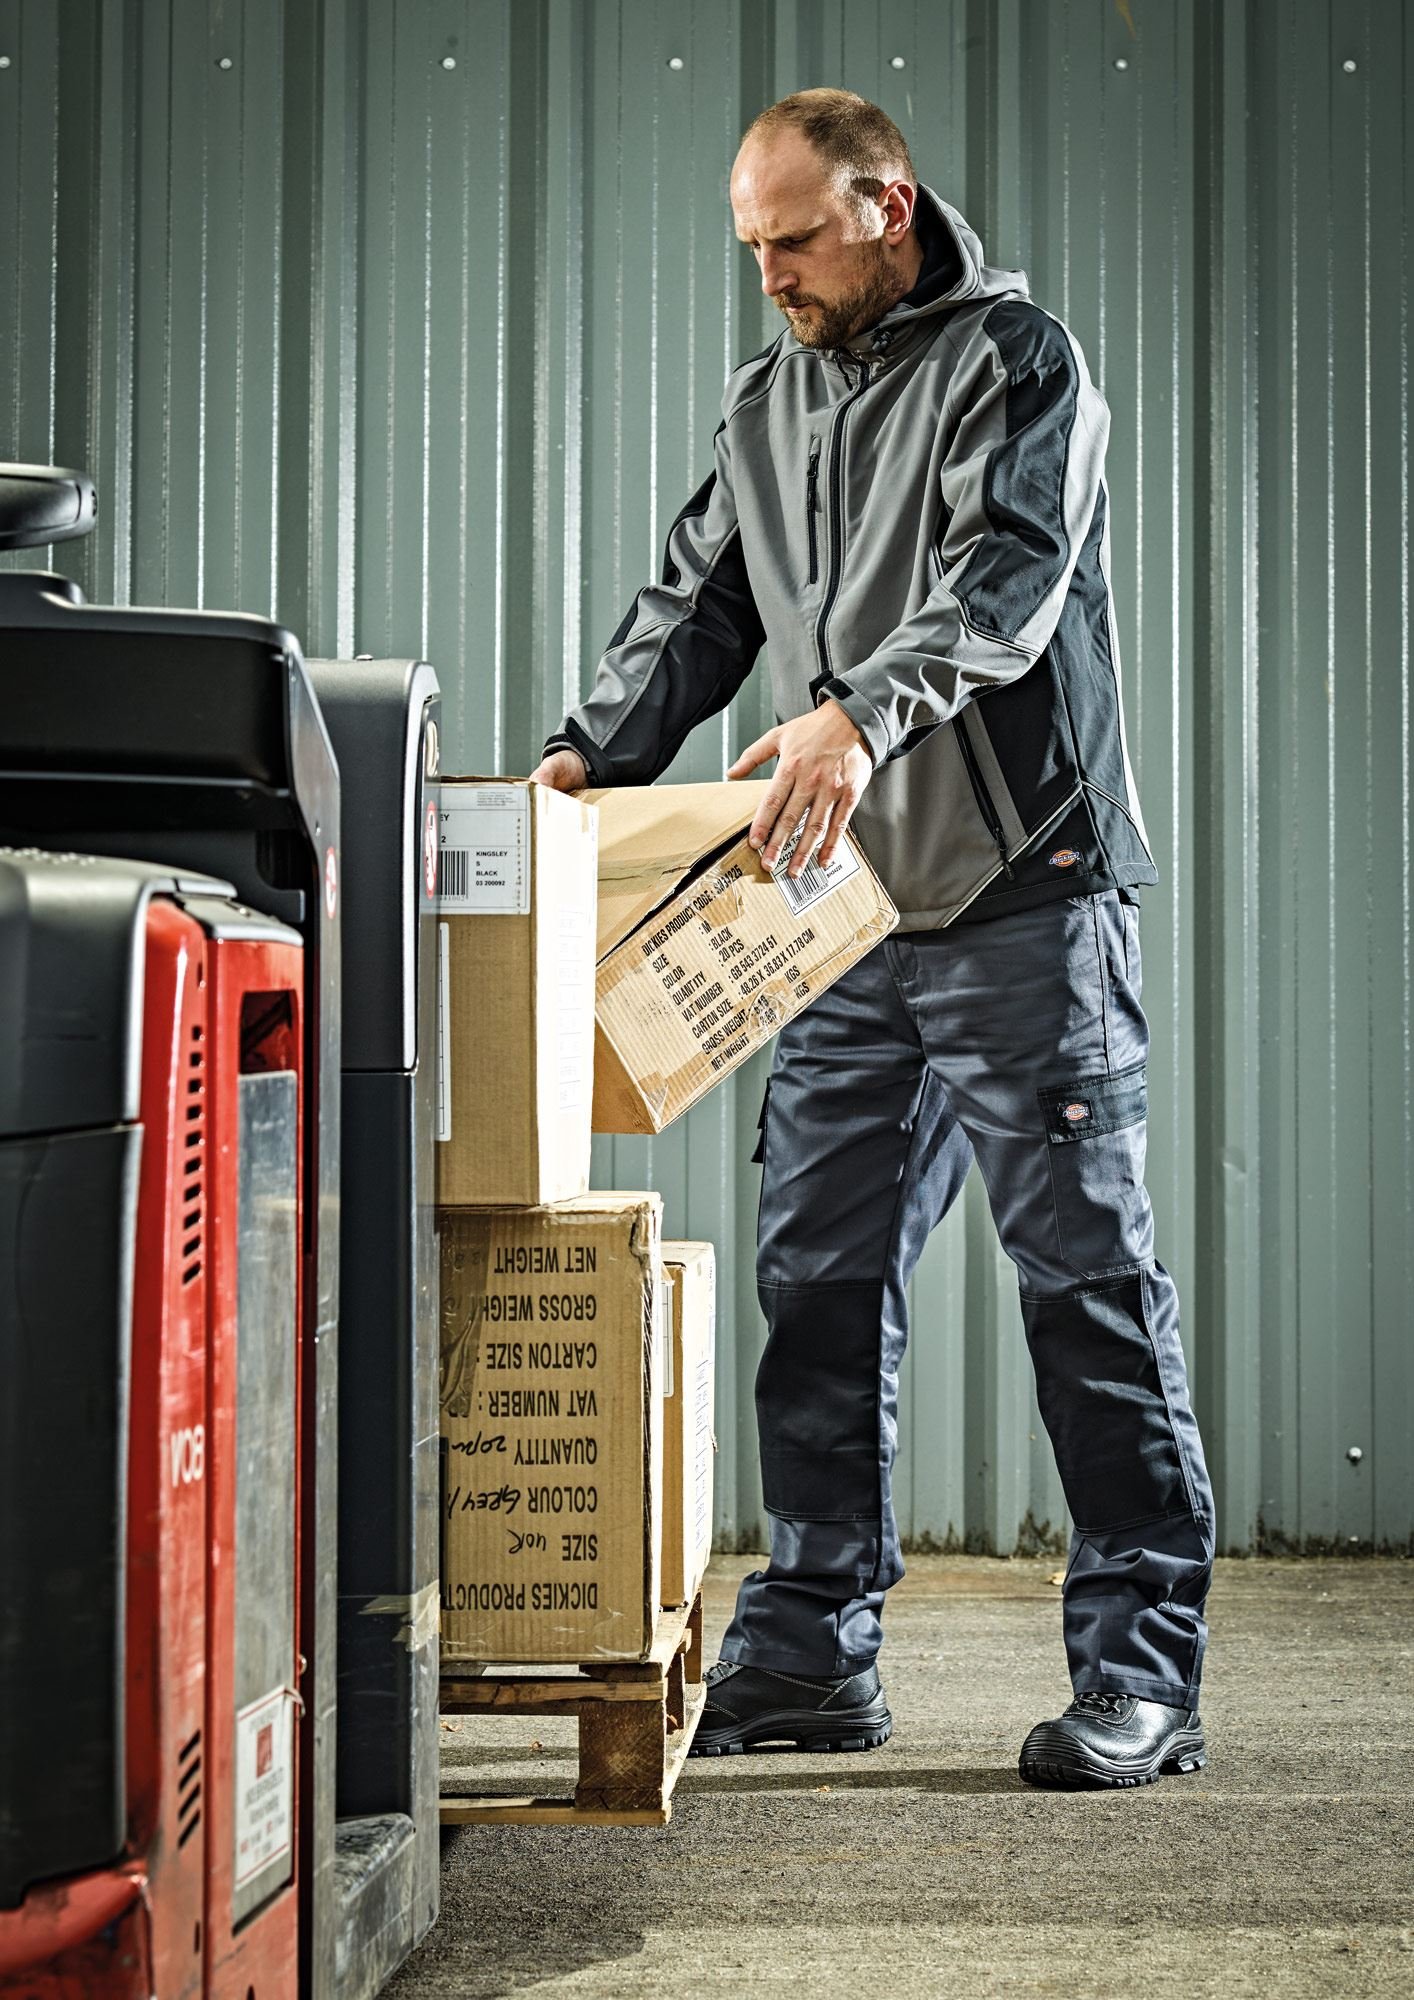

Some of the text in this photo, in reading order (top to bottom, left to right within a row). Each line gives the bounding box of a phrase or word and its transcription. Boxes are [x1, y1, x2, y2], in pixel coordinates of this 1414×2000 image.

[641, 928, 670, 957] DICKIES
[664, 905, 697, 937] PRODUCT
[651, 953, 670, 974] SIZE
[671, 970, 707, 1007] QUANTITY
[728, 938, 746, 957] PCS
[661, 964, 686, 990] COLOR
[681, 1004, 698, 1022] VAT
[693, 981, 725, 1012] NUMBER
[739, 954, 755, 973] 543
[750, 941, 770, 963] 3724
[690, 1010, 720, 1040] CARTON
[715, 997, 734, 1018] SIZE
[755, 969, 766, 983] X
[762, 954, 784, 977] 36.83
[777, 950, 789, 964] X
[784, 936, 806, 958] 17.78
[800, 927, 816, 945] CM
[700, 1029, 726, 1056] GROSS
[721, 1008, 750, 1038] WEIGHT
[784, 964, 801, 984] KGS
[710, 980, 811, 1072] NET WEIGHT KGS
[494, 1247, 596, 1273] NET WEIGHT
[482, 1295, 596, 1321] GROSS WEIGH
[486, 1343, 522, 1369] SIZE
[529, 1343, 596, 1369] CARTON
[488, 1390, 559, 1417] NUMBER
[567, 1390, 597, 1416] VAT
[514, 1437, 597, 1465] QUANTITY
[528, 1487, 597, 1513] COLOUR
[562, 1535, 597, 1561] SIZE
[446, 1583, 597, 1610] DICKIES PRODUCT
